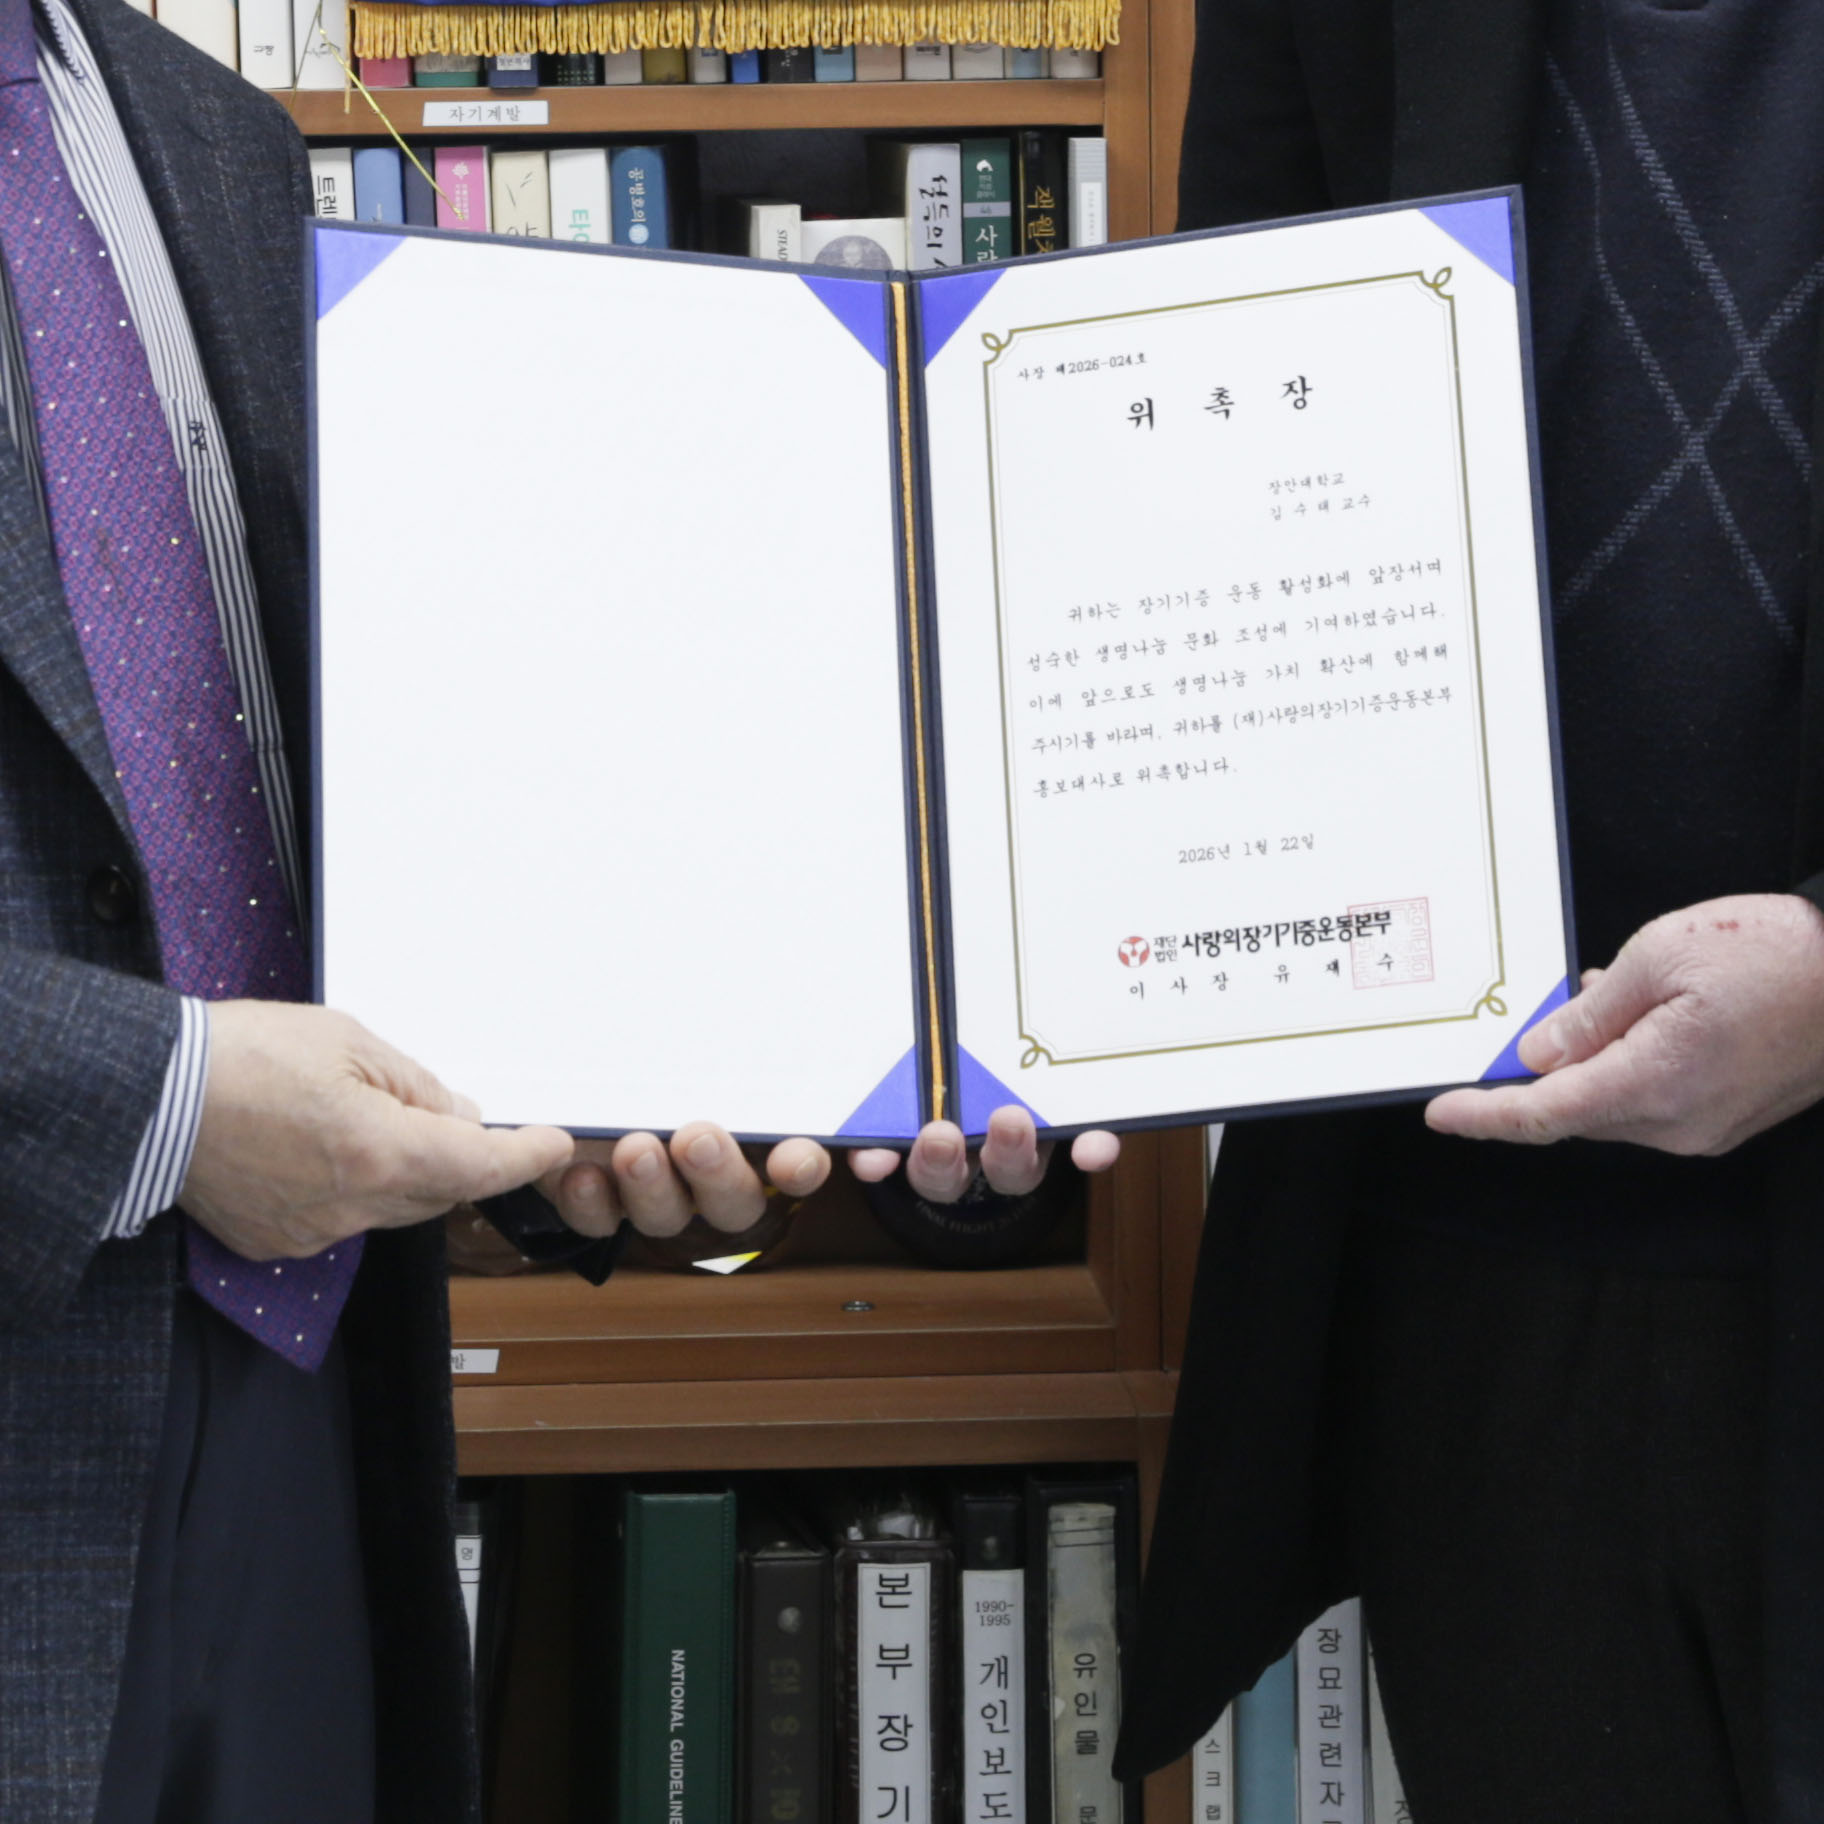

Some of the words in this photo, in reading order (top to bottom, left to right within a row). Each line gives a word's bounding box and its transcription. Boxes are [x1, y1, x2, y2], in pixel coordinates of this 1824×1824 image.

[449, 106, 522, 123] 자기계발
[1268, 472, 1345, 495] 장안대학교
[1068, 601, 1122, 624] 귀하는
[1138, 588, 1210, 616] 장기기증
[1227, 581, 1262, 603] 운동
[1279, 570, 1350, 596] 활성화에
[1368, 558, 1442, 585] 앞장서며
[1028, 648, 1080, 672] 성숙한
[1096, 637, 1167, 663] 생명나눔
[1184, 630, 1219, 651] 문화
[1235, 621, 1287, 643] 조성에
[1305, 602, 1446, 632] 기여하였습니다.
[1029, 693, 1062, 712] 이에
[1081, 683, 1156, 708] 앞으로도
[1172, 669, 1247, 695] 생명나눔
[1266, 662, 1300, 681] 가치
[1320, 652, 1373, 675] 확산에
[1031, 731, 1096, 755] 주시기를
[1173, 714, 1223, 736] 귀하를
[1033, 771, 1125, 799] 홍보대사로
[1137, 756, 1237, 783] 위촉합니다.
[1178, 844, 1231, 864] 2026년
[1243, 839, 1268, 856] 1월
[1280, 833, 1314, 852] 22일
[1153, 935, 1177, 949] 재단
[1154, 949, 1178, 963] 법인
[1181, 910, 1392, 959] 사랑의장기기증운동본부
[979, 1614, 1011, 1626] 1995
[670, 1649, 685, 1733] NATIONAL
[1072, 1651, 1100, 1756] 유인물
[979, 1655, 1012, 1821] 개인보도
